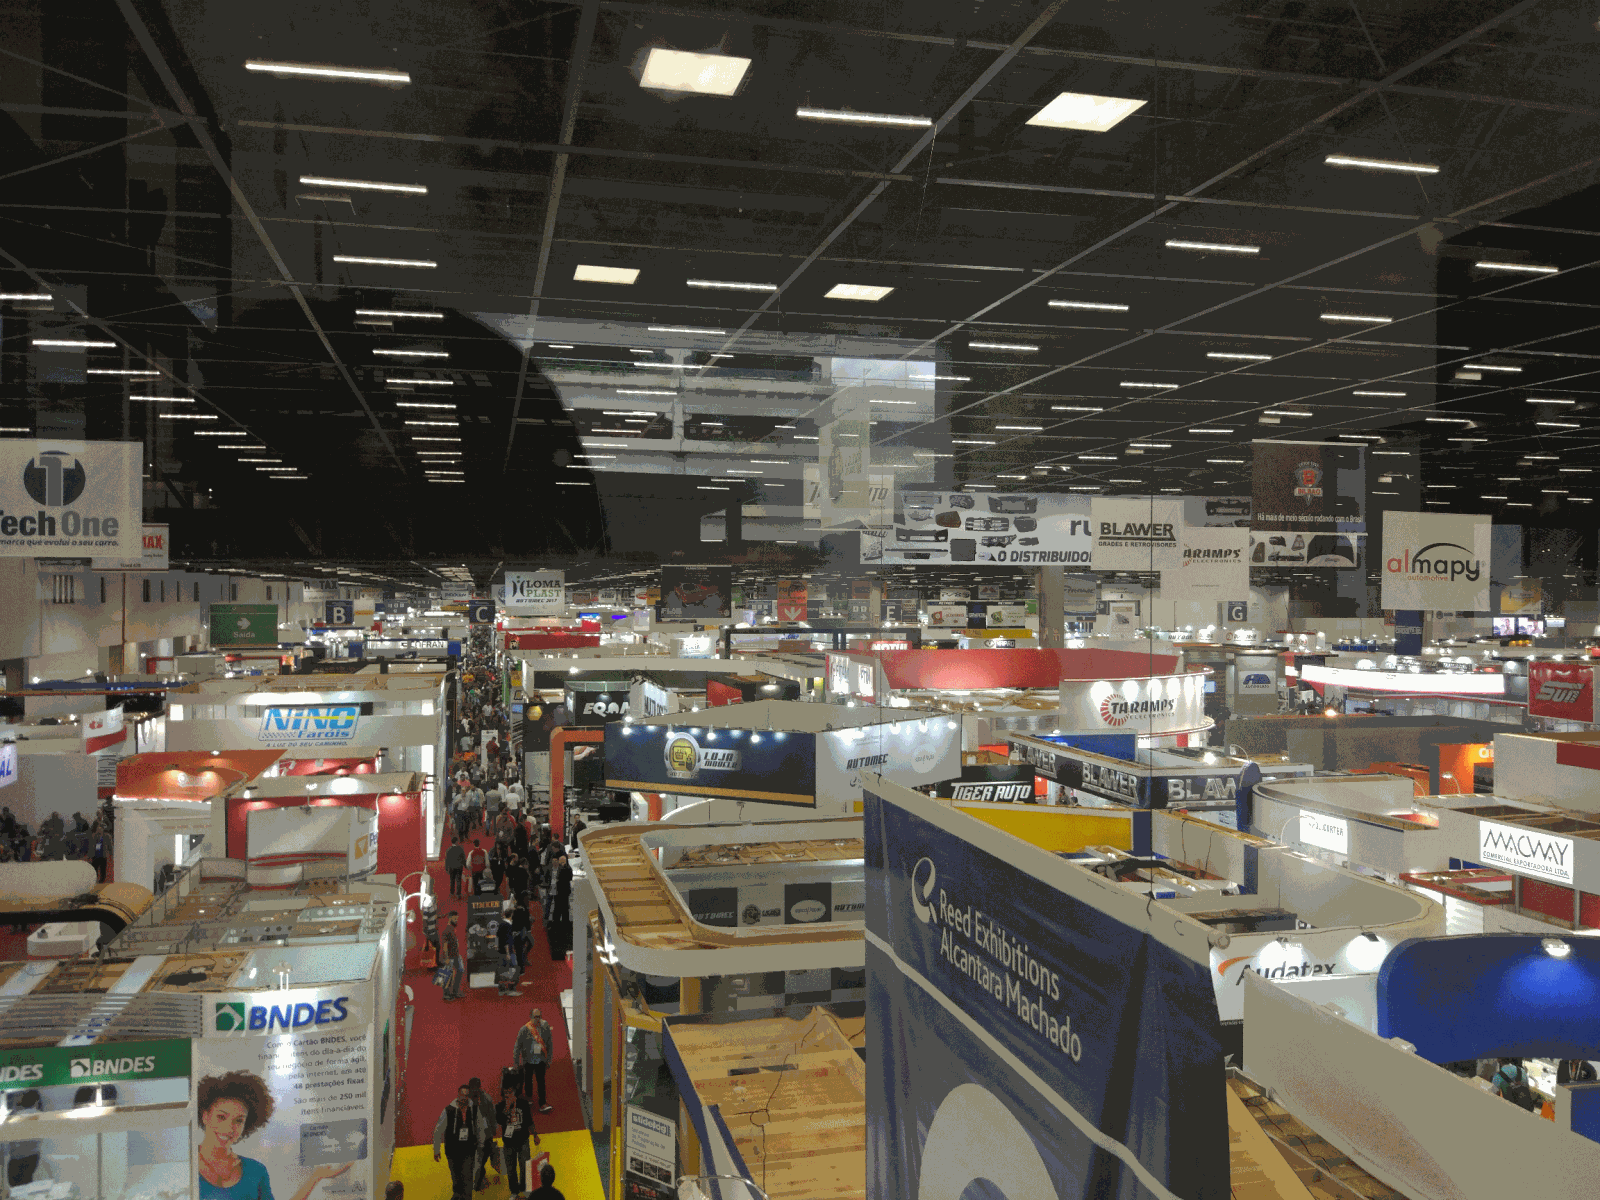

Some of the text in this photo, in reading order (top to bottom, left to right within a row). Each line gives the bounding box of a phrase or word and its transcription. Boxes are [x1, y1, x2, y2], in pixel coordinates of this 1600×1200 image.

[61, 510, 119, 537] One
[1257, 512, 1265, 521] Há
[1265, 513, 1278, 521] mais
[1278, 513, 1285, 521] de
[1286, 513, 1298, 522] meio
[1298, 513, 1314, 522] século
[1314, 513, 1334, 523] rodando
[1334, 515, 1345, 523] com
[1350, 514, 1364, 523] Brasil
[1100, 522, 1174, 538] BLAWER
[26, 540, 43, 548] que
[44, 538, 70, 546] evolui
[997, 550, 1092, 562] O DISTRIBUIDO
[1387, 546, 1480, 582] almapy
[526, 580, 561, 589] LOMA
[1407, 574, 1449, 582] automotive
[526, 588, 562, 598] PLAST
[332, 607, 347, 624] B
[475, 606, 489, 623] C
[886, 605, 896, 621] E
[1231, 606, 1243, 621] G
[1111, 698, 1175, 715] TARAMPS
[703, 751, 735, 762] LOJA
[846, 753, 889, 770] AUTOMEC
[1081, 761, 1139, 800] BLAWER
[950, 782, 1032, 803] TIGER AUTO
[1482, 828, 1569, 867] MACWAY
[1482, 850, 1513, 864] COMERCIAL
[1513, 857, 1553, 873] EXPORTADORA
[939, 887, 1060, 1001] Reed Exhibitions
[939, 928, 1083, 1063] Alcantara Machado
[248, 996, 349, 1031] BNDES
[293, 1038, 319, 1047] Cartão
[349, 1034, 367, 1043] você
[309, 1048, 321, 1057] do
[355, 1045, 368, 1053] do
[92, 1056, 156, 1076] BNDES
[325, 1057, 349, 1066] forma
[287, 1072, 305, 1080] pela
[354, 1066, 367, 1074] até
[304, 1080, 345, 1091] prestações
[293, 1090, 367, 1105] São mais de 250 mil
[300, 1106, 320, 1116] itens
